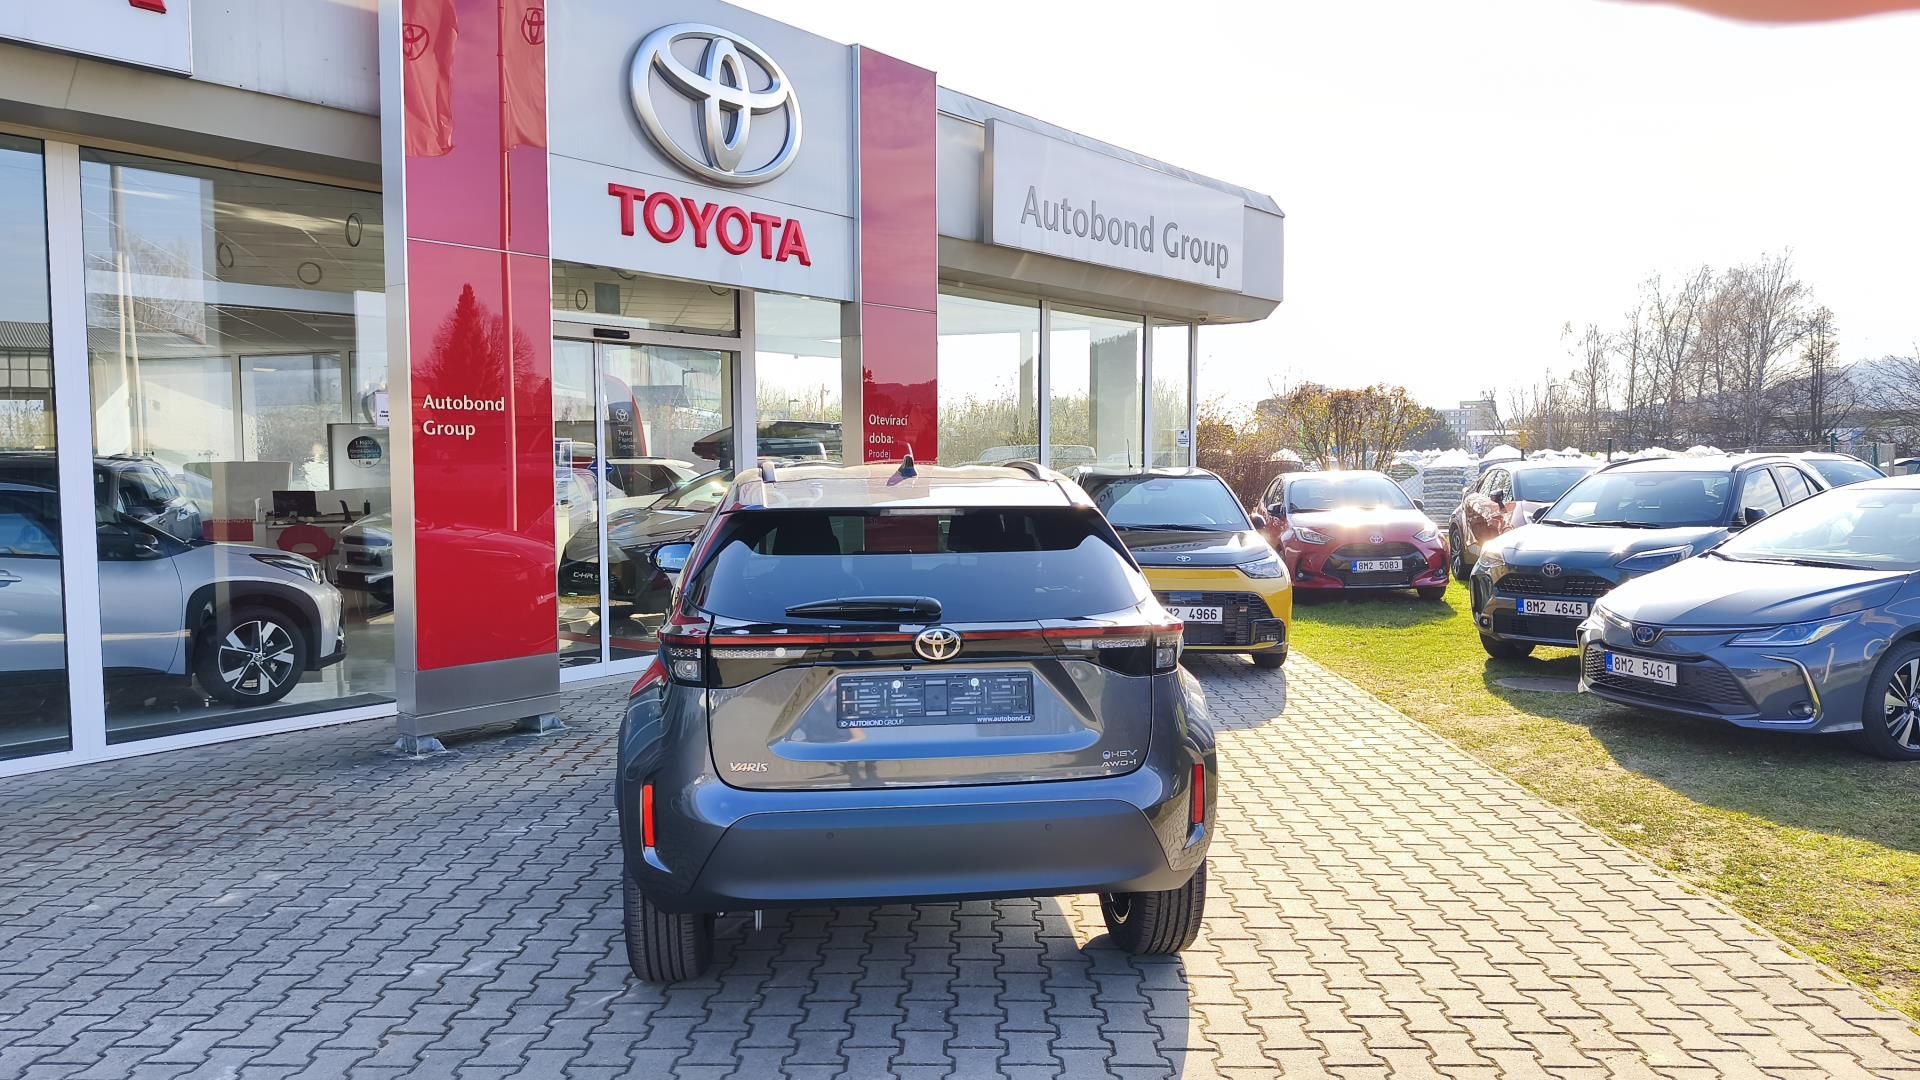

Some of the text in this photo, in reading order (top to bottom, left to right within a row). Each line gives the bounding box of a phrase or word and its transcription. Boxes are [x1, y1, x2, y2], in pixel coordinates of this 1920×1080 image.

[608, 182, 811, 266] TOYOTA
[1021, 185, 1229, 278] Autobond Group
[422, 394, 505, 412] Autobond
[868, 414, 909, 426] Otevírací
[423, 420, 476, 441] Group
[869, 432, 894, 444] doba:
[868, 449, 892, 460] Prodej
[1358, 561, 1374, 570] 8M2
[1379, 561, 1399, 570] 5083
[573, 571, 594, 580] C-HR
[1526, 600, 1583, 615] 8M2 4645
[1188, 608, 1217, 620] 4966
[1614, 656, 1671, 681] 8M2 5461
[884, 718, 905, 726] GROUP
[976, 714, 1032, 723] www.autobond.cz
[1111, 749, 1138, 758] HEV
[729, 761, 769, 772] YARIS
